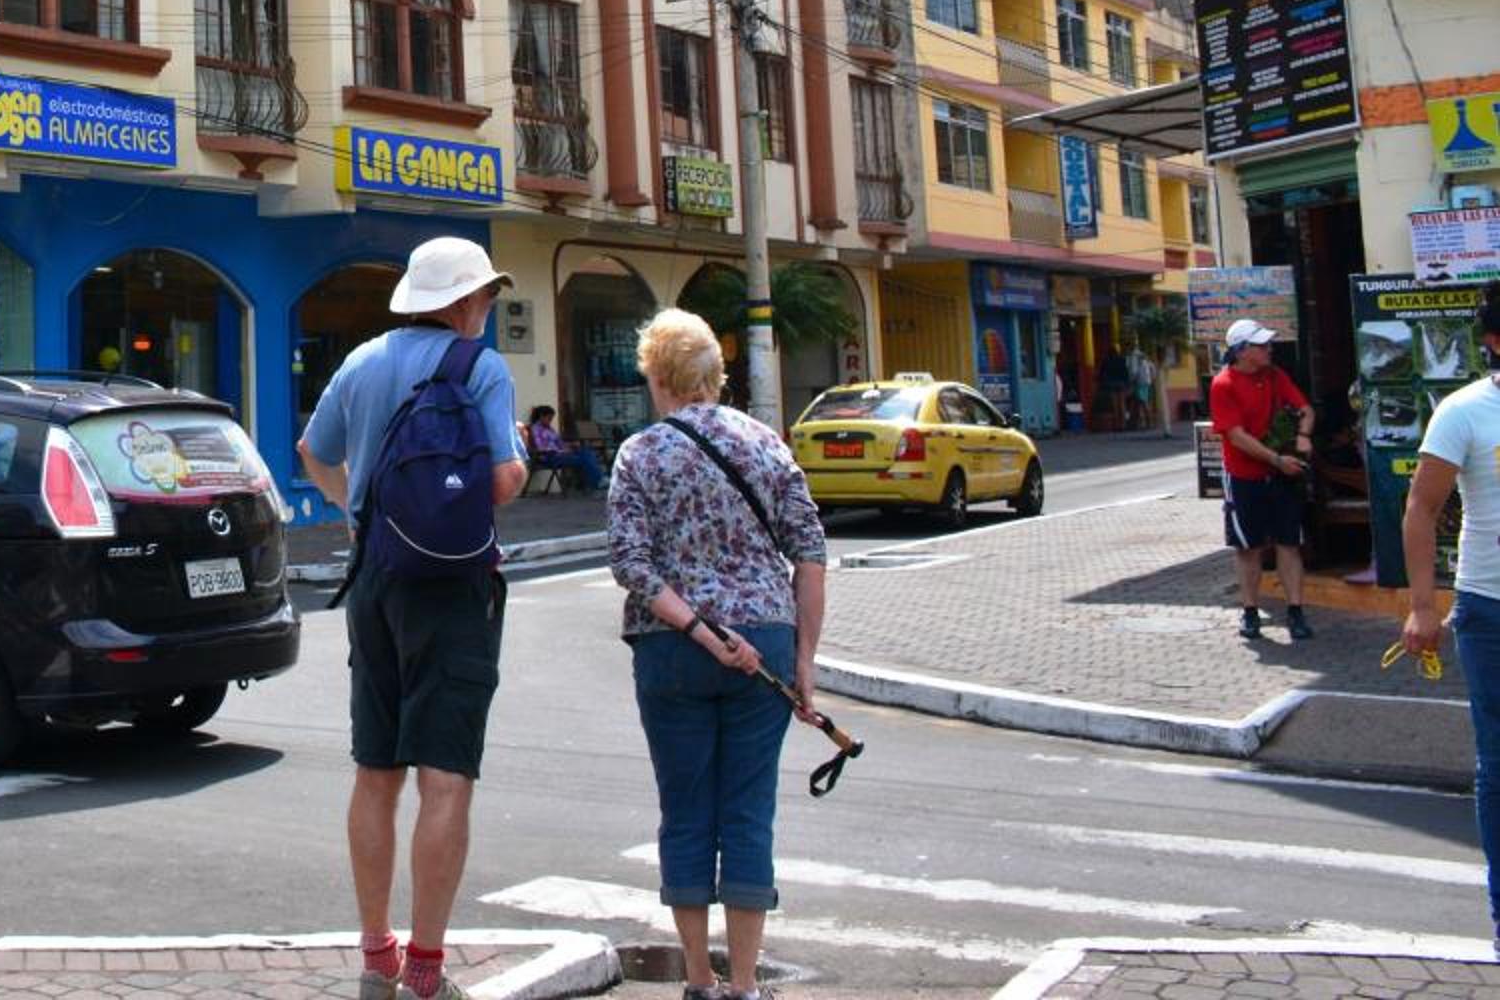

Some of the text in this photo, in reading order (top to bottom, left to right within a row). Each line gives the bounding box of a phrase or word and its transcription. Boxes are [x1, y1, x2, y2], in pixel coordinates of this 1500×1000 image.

[49, 116, 171, 155] ALMACENES
[357, 137, 498, 196] LA GANGA
[1423, 294, 1442, 305] DE
